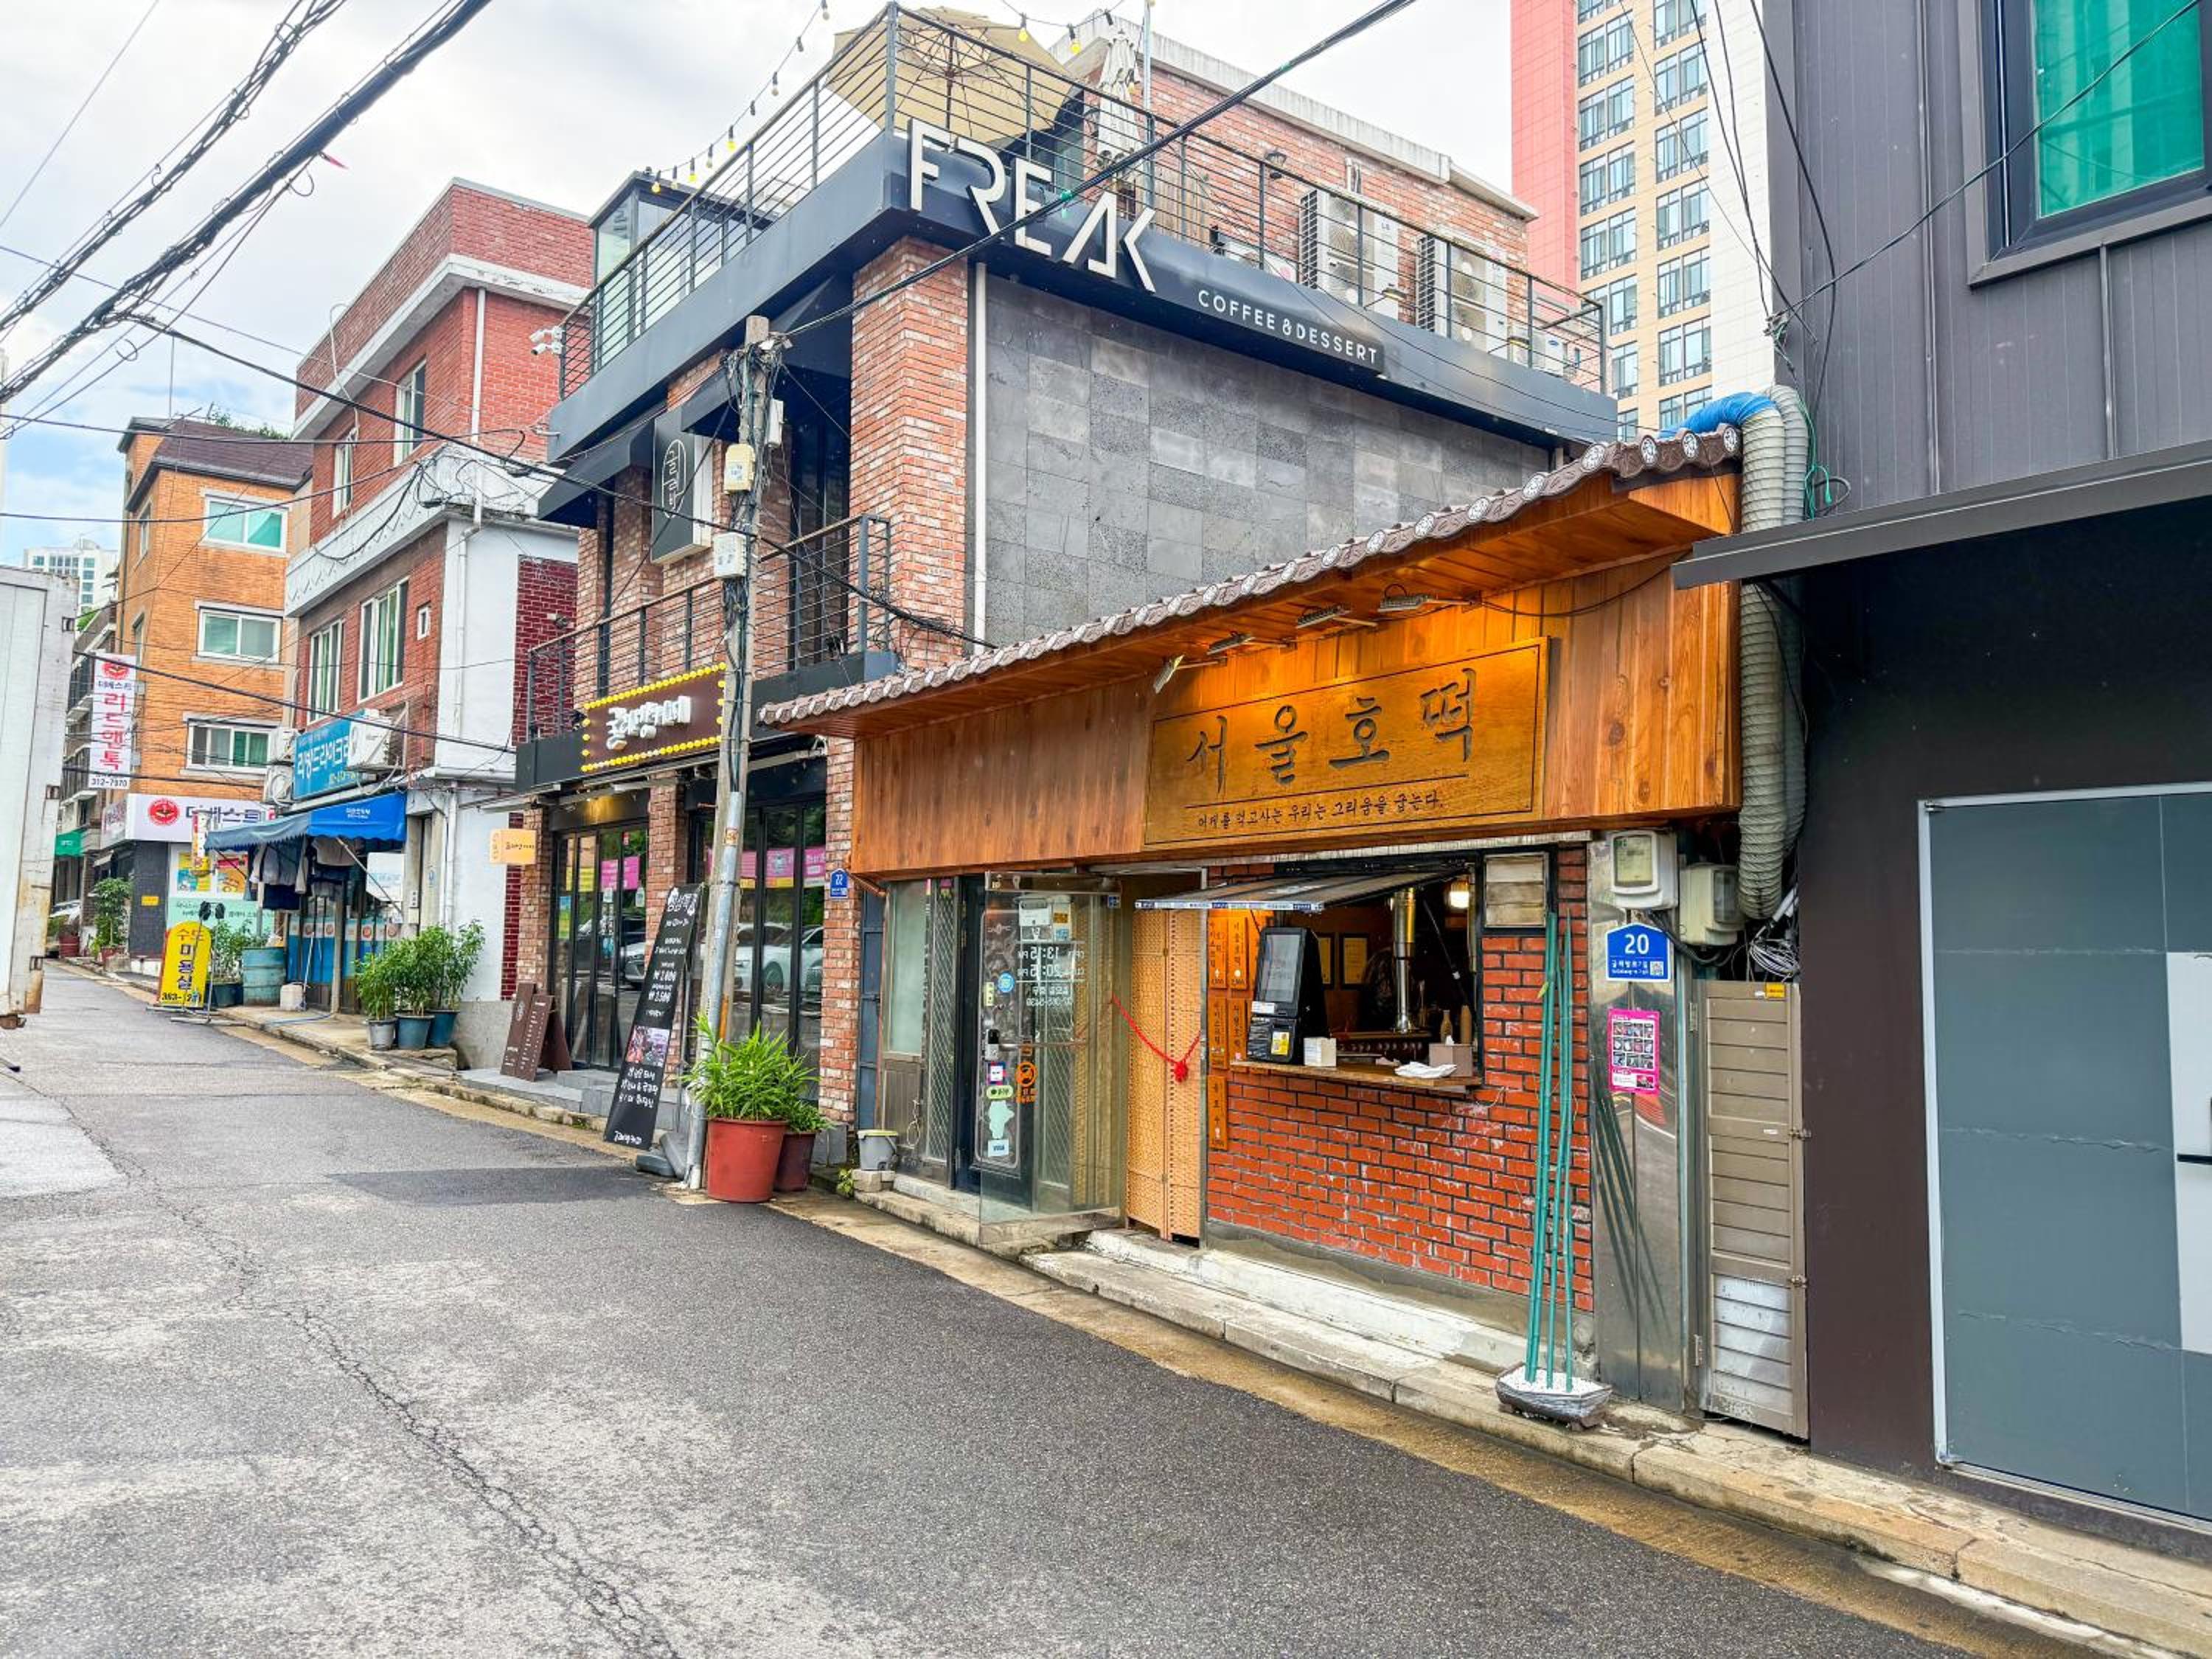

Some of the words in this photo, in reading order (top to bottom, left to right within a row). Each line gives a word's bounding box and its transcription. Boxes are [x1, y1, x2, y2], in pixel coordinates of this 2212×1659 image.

[911, 117, 1156, 293] FREAK
[1198, 290, 1276, 330] COFFEE
[1187, 668, 1475, 794] 서울호떡
[1288, 803, 1326, 821] 우리는
[1332, 797, 1388, 817] 그리움을
[1395, 790, 1444, 811] 굽는다.
[835, 874, 843, 885] 22
[1624, 933, 1650, 954] 20
